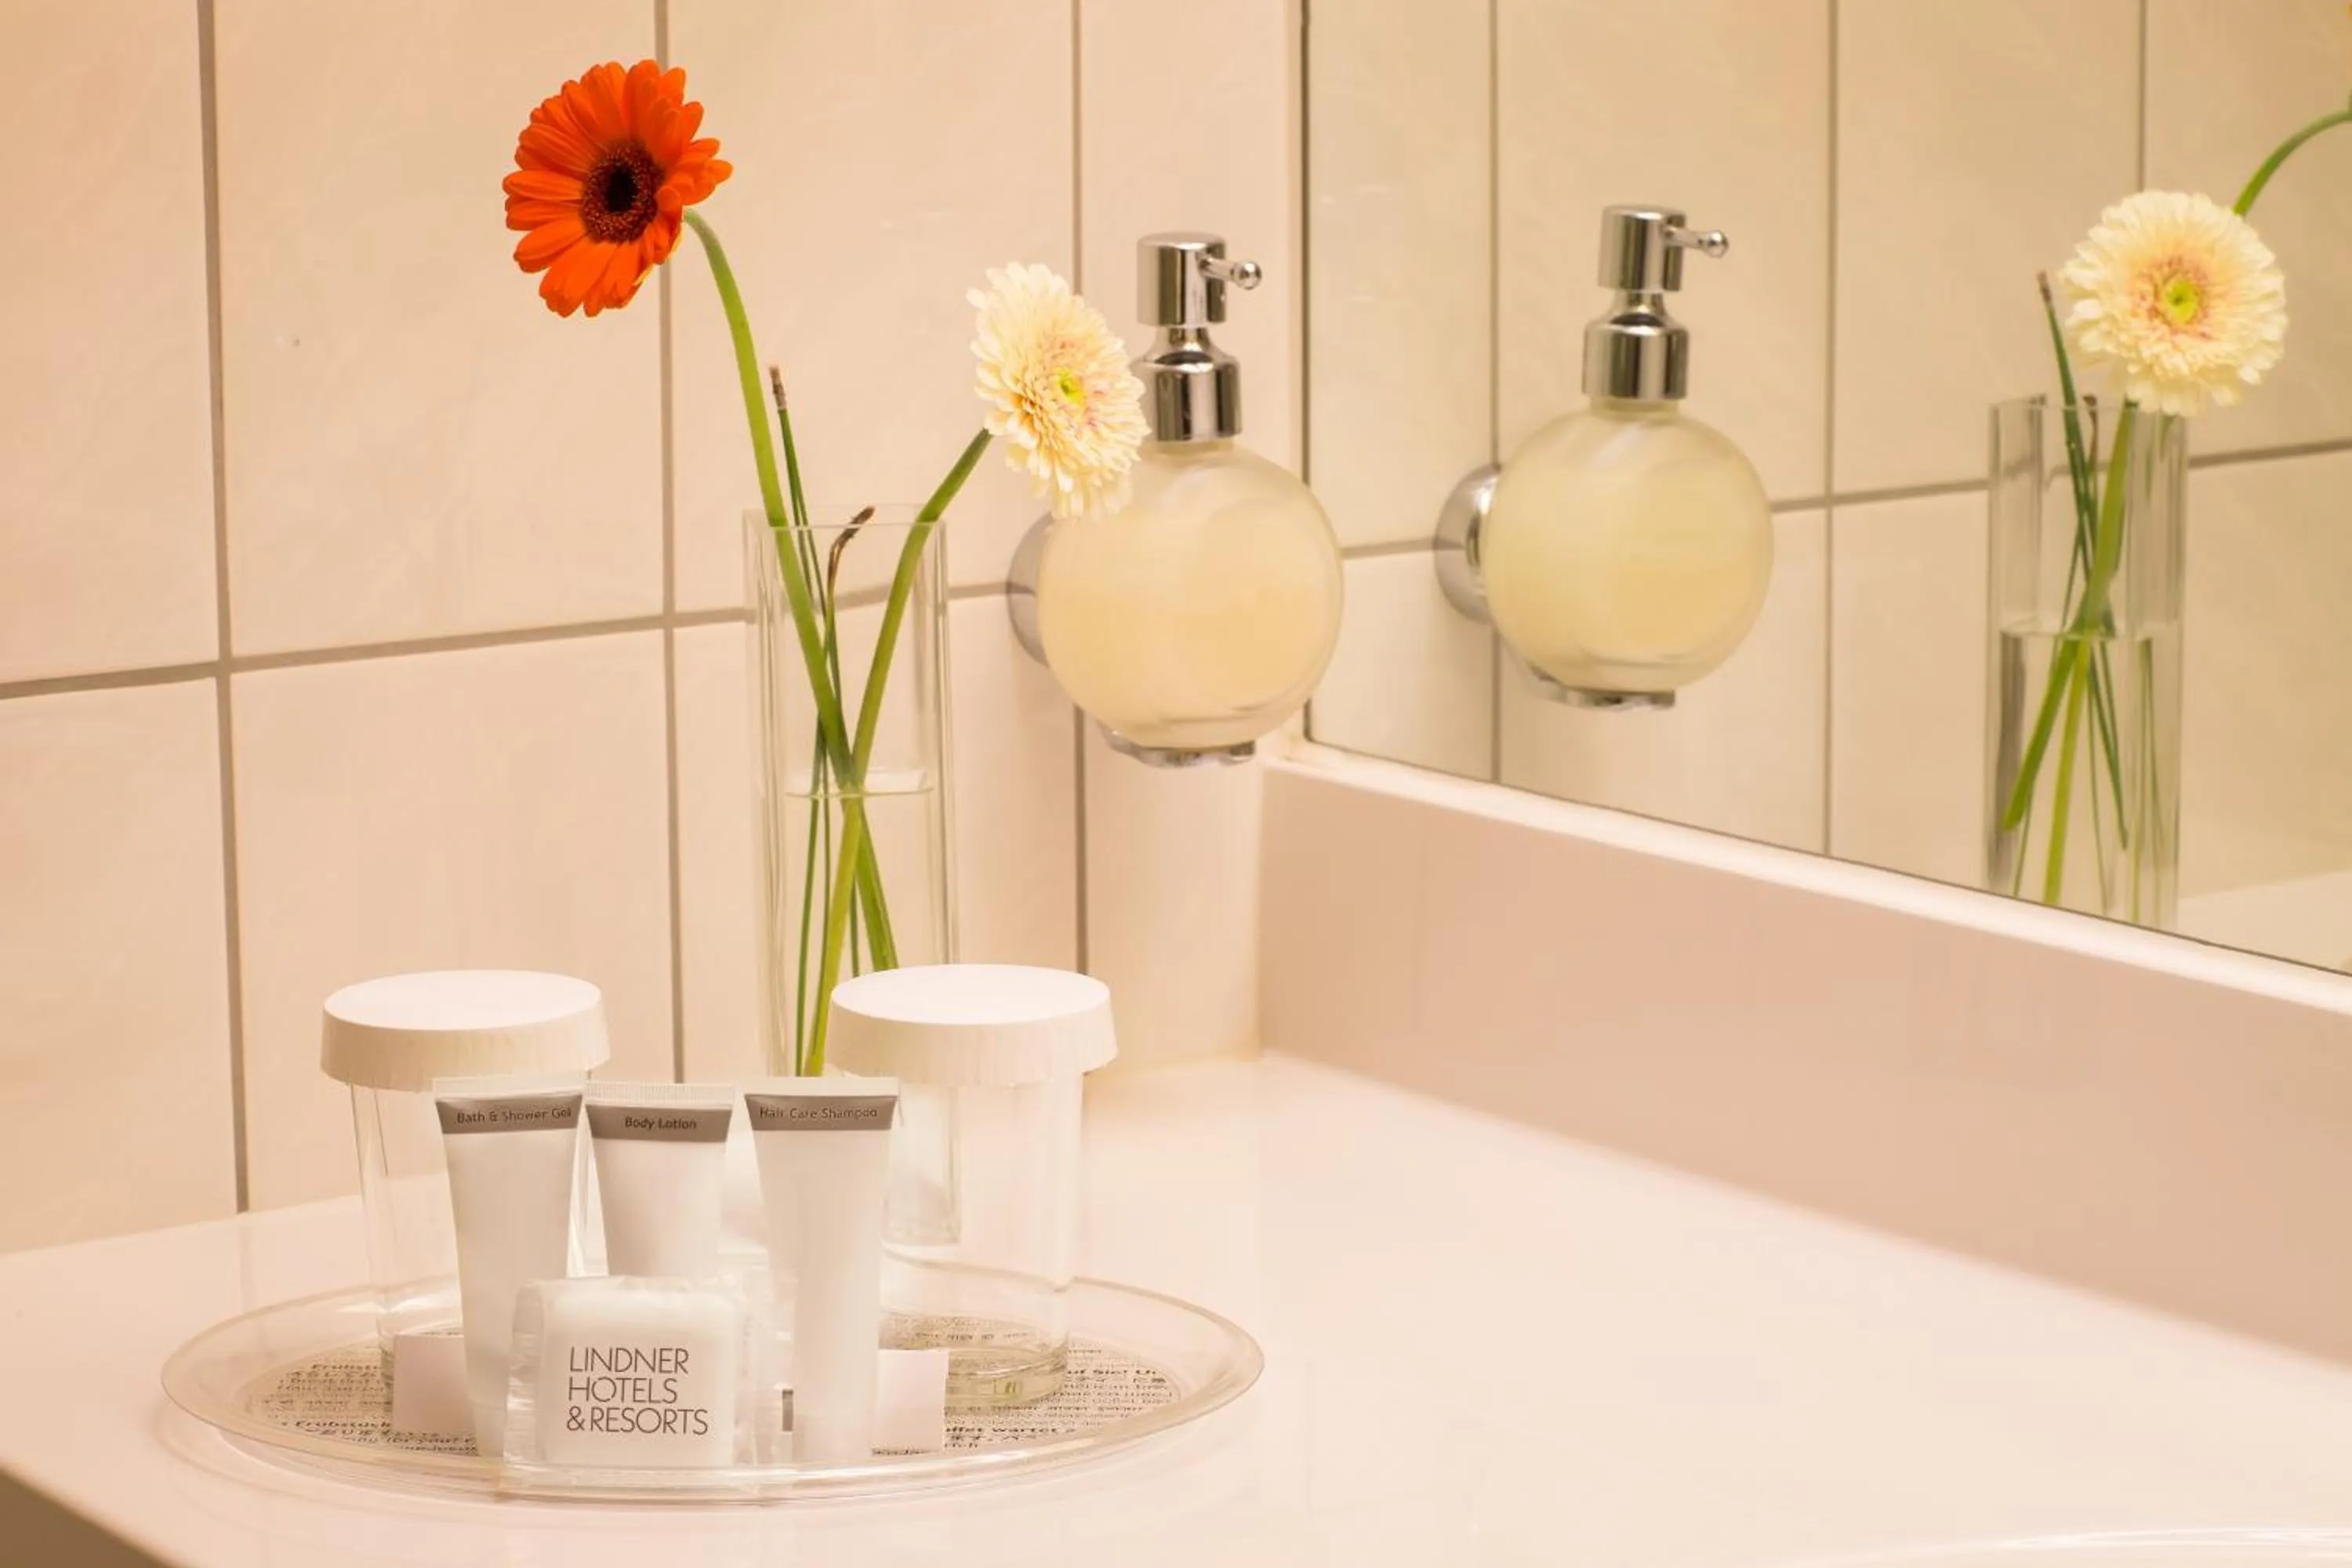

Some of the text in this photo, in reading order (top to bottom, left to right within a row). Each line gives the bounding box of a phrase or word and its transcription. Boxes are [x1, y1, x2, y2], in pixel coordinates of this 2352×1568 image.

[457, 1107, 572, 1123] Bath & Shower Gel
[760, 1106, 877, 1121] Hair Care Shampoo
[625, 1116, 697, 1131] Body Lotion
[570, 1346, 690, 1375] LINDNER
[568, 1376, 678, 1404] HOTELS
